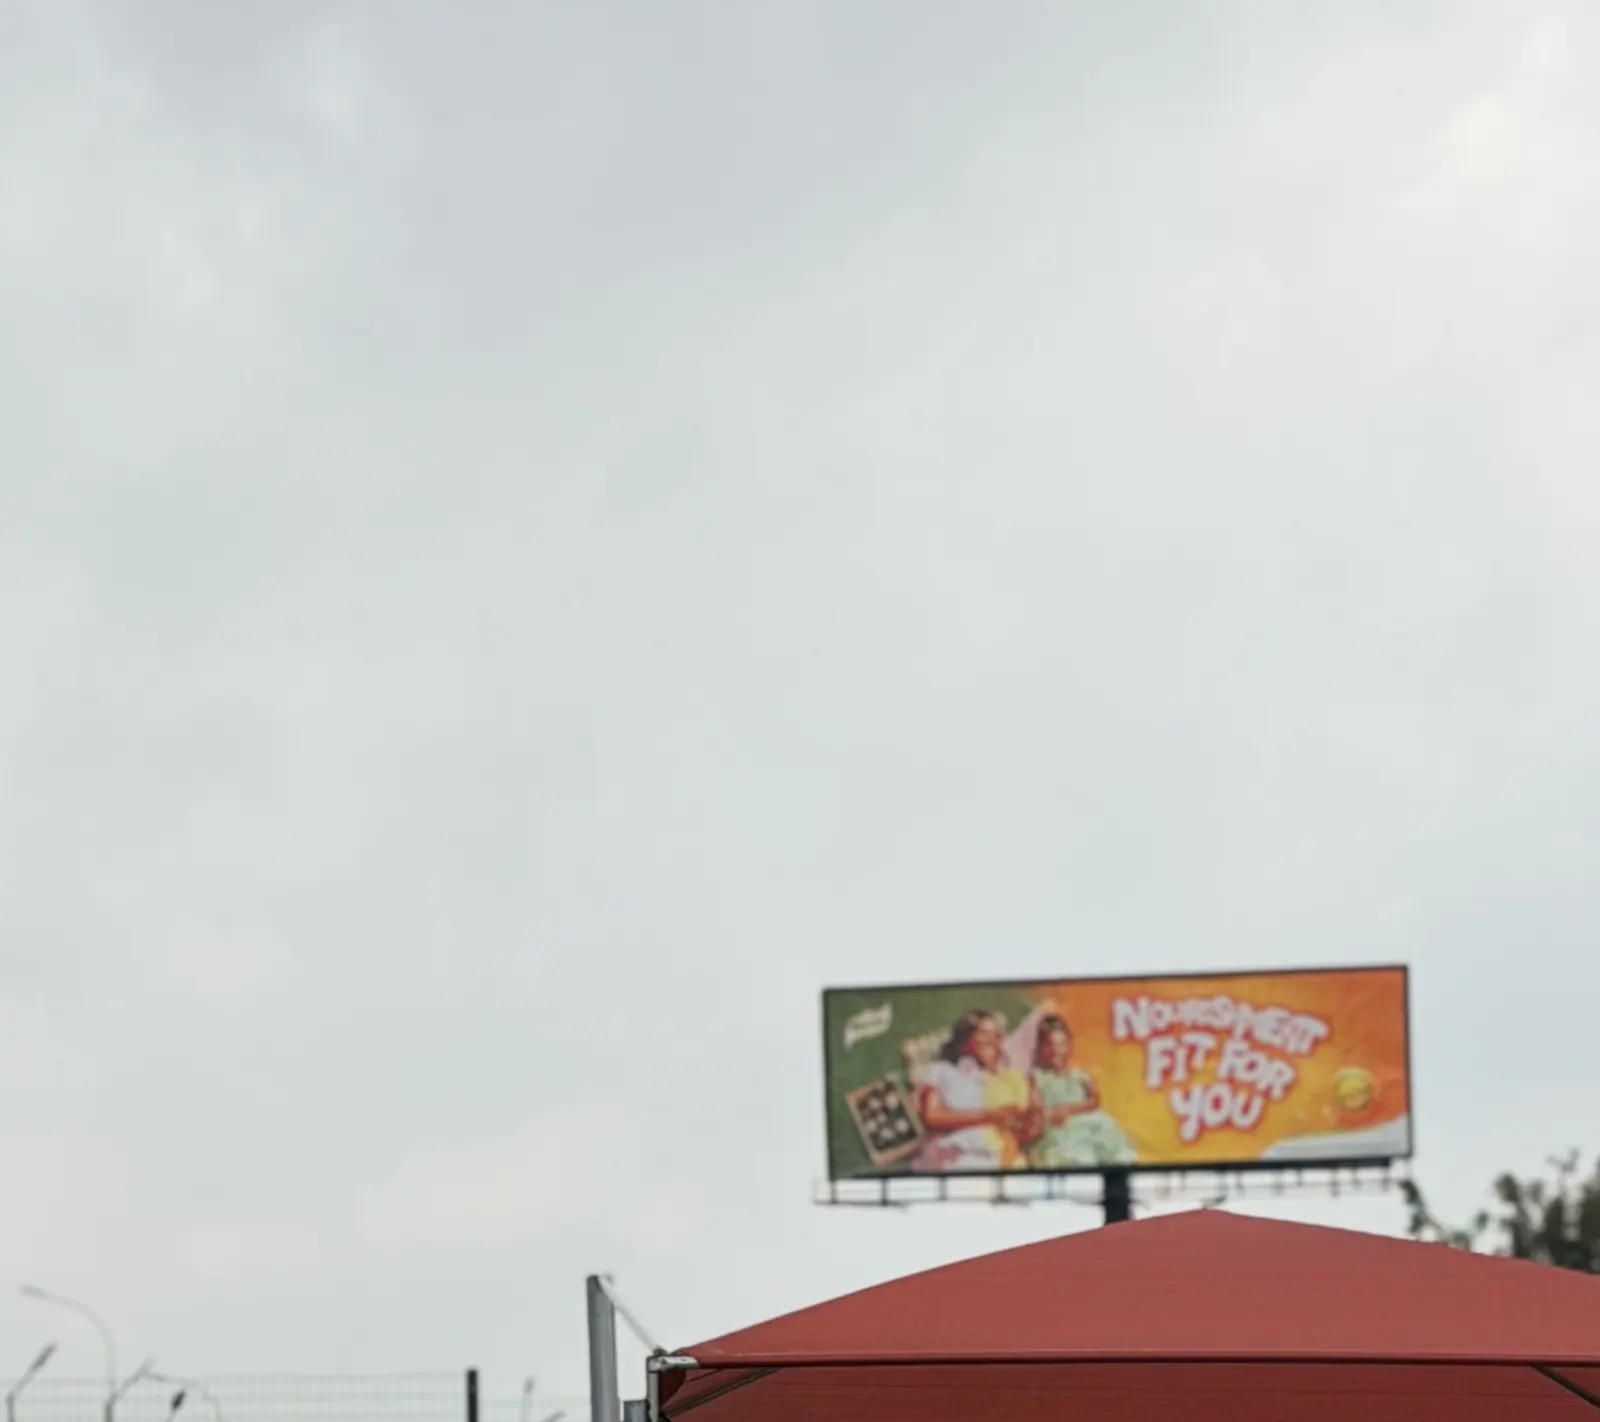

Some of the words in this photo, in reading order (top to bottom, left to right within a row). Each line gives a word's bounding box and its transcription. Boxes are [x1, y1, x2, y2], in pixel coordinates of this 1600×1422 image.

[1147, 1031, 1216, 1089] FIT
[1217, 1041, 1295, 1099] FOR
[1168, 1083, 1263, 1141] YOU
